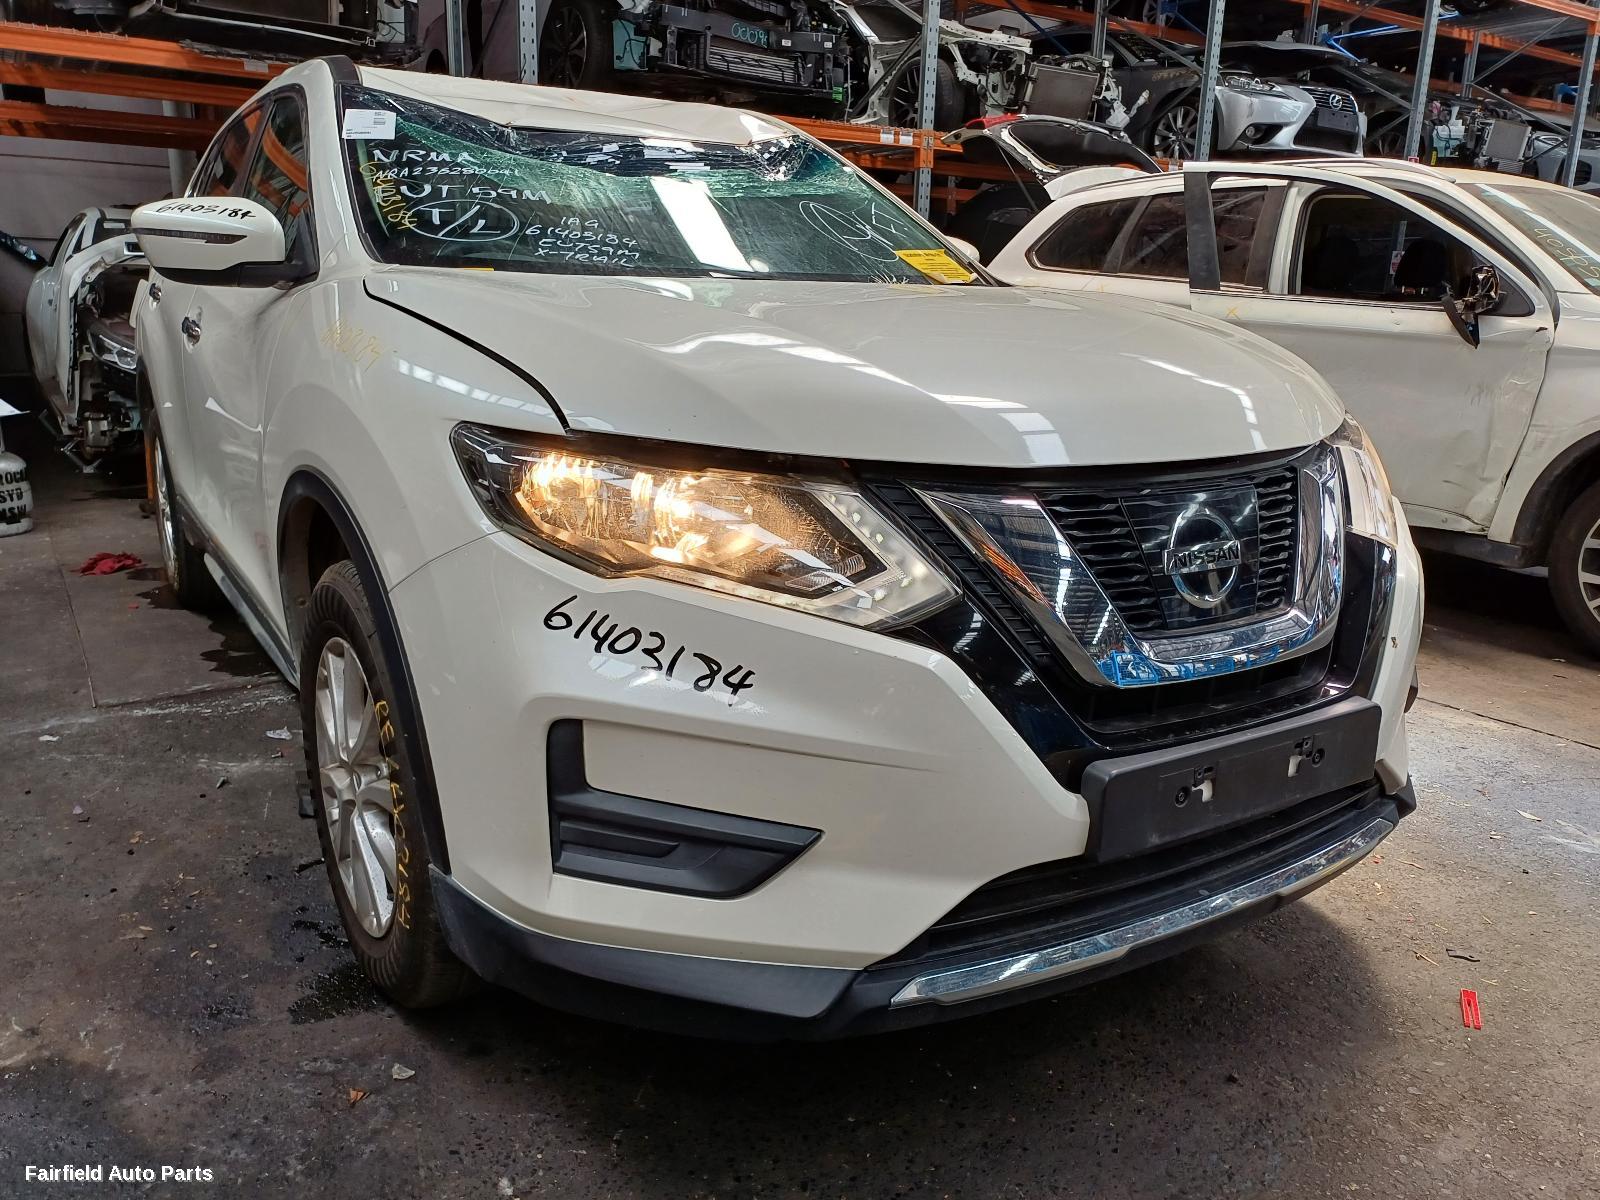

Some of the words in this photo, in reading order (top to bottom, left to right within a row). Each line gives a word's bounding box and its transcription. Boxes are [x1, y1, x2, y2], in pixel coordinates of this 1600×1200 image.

[373, 149, 480, 163] NRMA
[156, 202, 256, 219] 61403184
[525, 224, 638, 248] 61403184
[534, 248, 634, 267] X-TRAIL
[1172, 544, 1240, 569] NISSAN
[543, 594, 756, 707] 61403184
